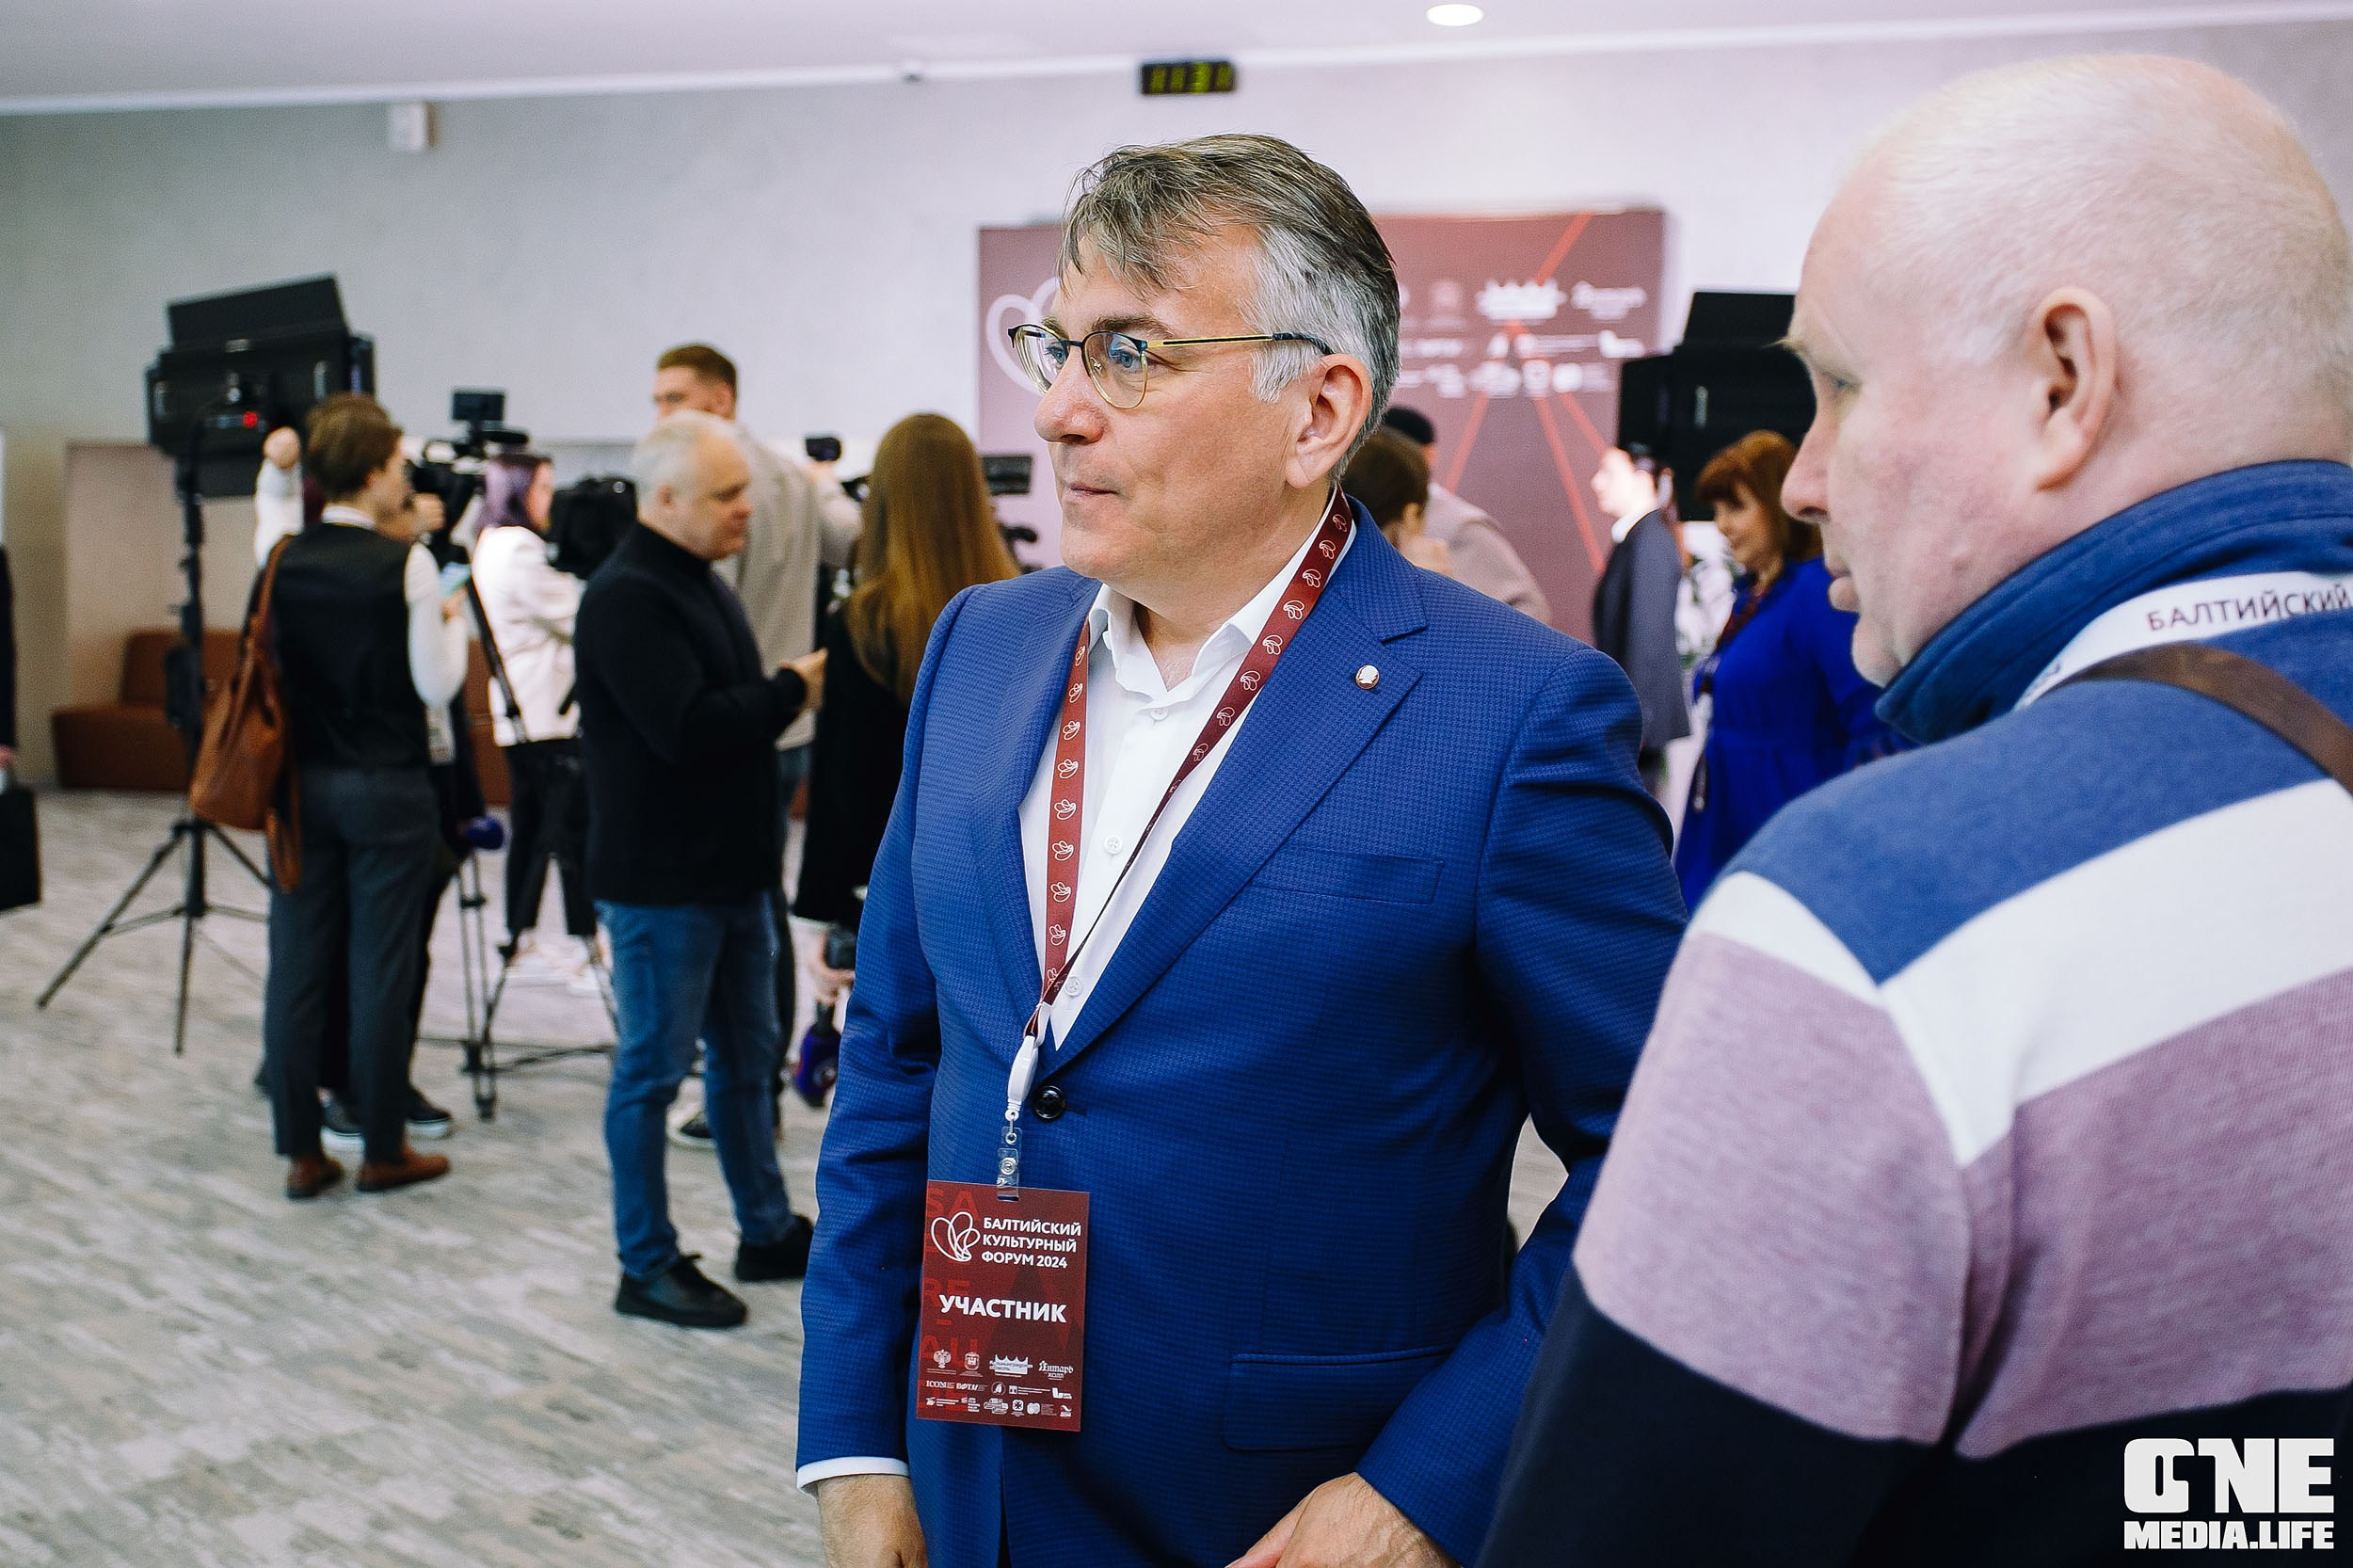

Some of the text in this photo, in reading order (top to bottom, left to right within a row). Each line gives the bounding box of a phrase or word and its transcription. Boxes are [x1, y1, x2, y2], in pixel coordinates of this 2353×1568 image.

[2147, 584, 2352, 632] БАЛТИЙСКИЙ
[984, 1217, 1081, 1237] БАЛТИЙСКИЙ
[982, 1234, 1077, 1253] КУЛЬТУРНЫЙ
[981, 1251, 1033, 1266] ФОРУМ
[1036, 1255, 1067, 1269] 2024
[938, 1294, 1067, 1322] УЧАСТНИК
